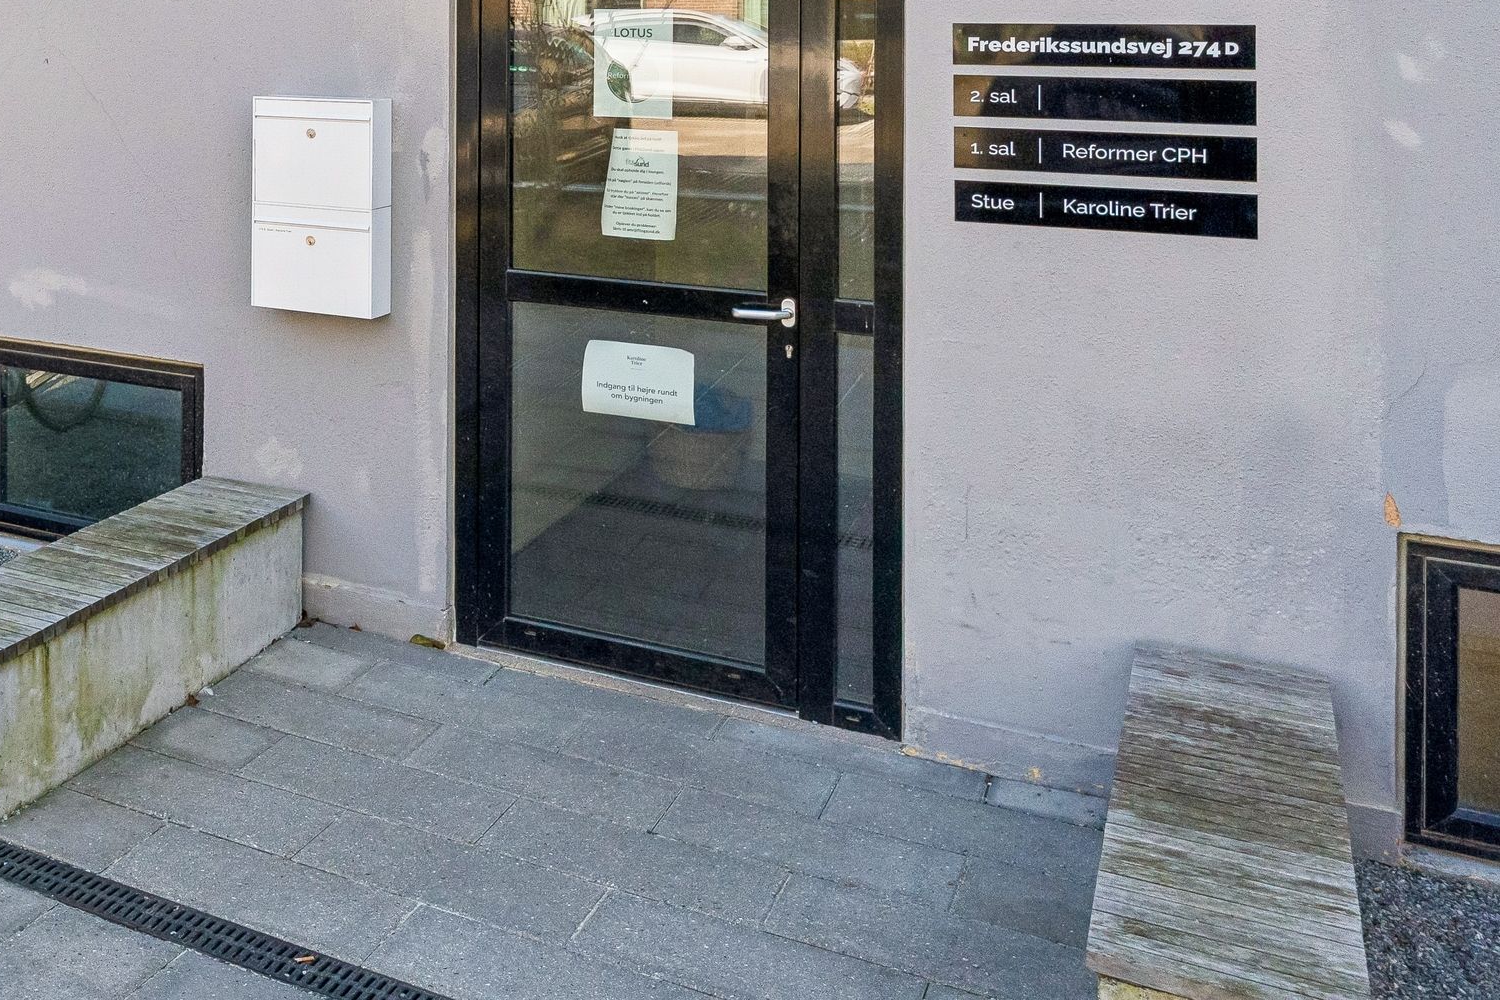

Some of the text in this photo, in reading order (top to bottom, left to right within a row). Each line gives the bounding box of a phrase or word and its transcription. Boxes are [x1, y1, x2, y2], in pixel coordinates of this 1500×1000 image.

[614, 27, 653, 38] LOTUS
[967, 36, 1240, 59] Frederikssundsvej 274 D
[970, 88, 1018, 104] 2. sal
[970, 141, 1016, 156] 1. sal
[1062, 143, 1207, 164] Reformer CPH
[971, 193, 1198, 221] Stue Karoline Trier
[596, 381, 678, 397] Indgang til højre rundt
[624, 393, 664, 405] bygningen
